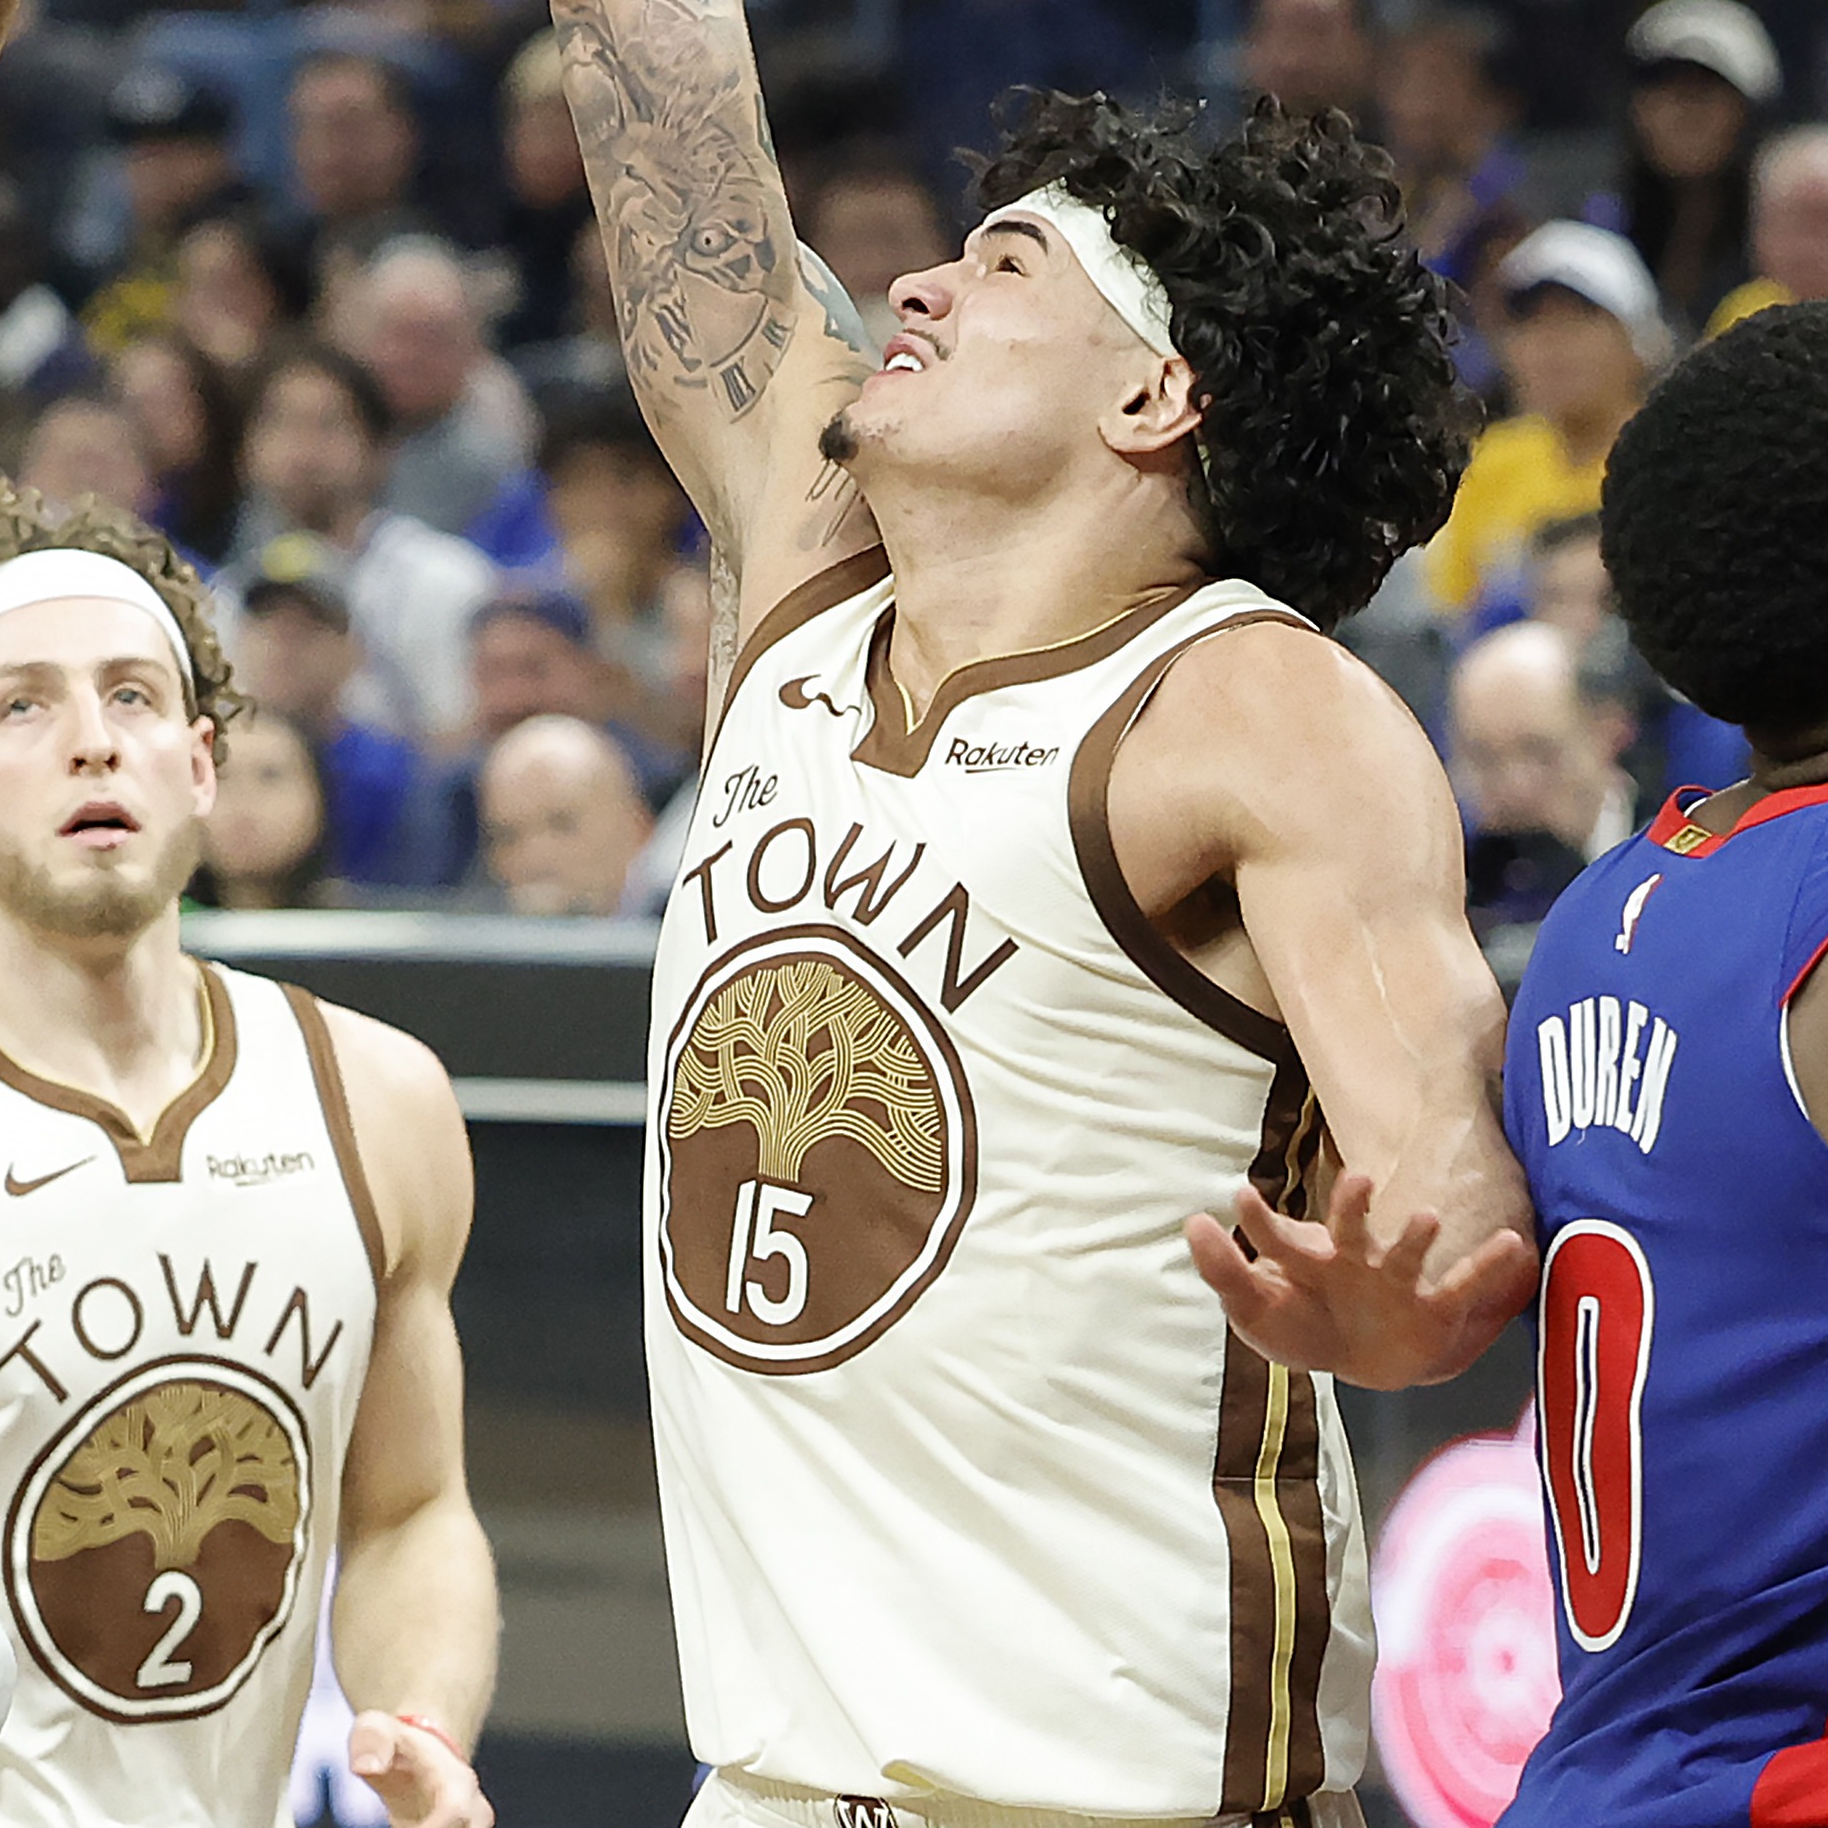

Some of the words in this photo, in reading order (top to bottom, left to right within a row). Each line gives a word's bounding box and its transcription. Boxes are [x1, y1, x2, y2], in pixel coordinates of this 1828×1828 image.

[712, 764, 778, 828] The
[944, 738, 1060, 770] Rakuten
[682, 817, 1020, 1015] TOWN
[1537, 995, 1678, 1155] DUREN
[206, 1151, 315, 1182] Rakuten
[3, 1253, 66, 1317] The
[725, 1179, 814, 1326] 15
[1537, 1218, 1655, 1653] 0
[135, 1570, 203, 1689] 2
